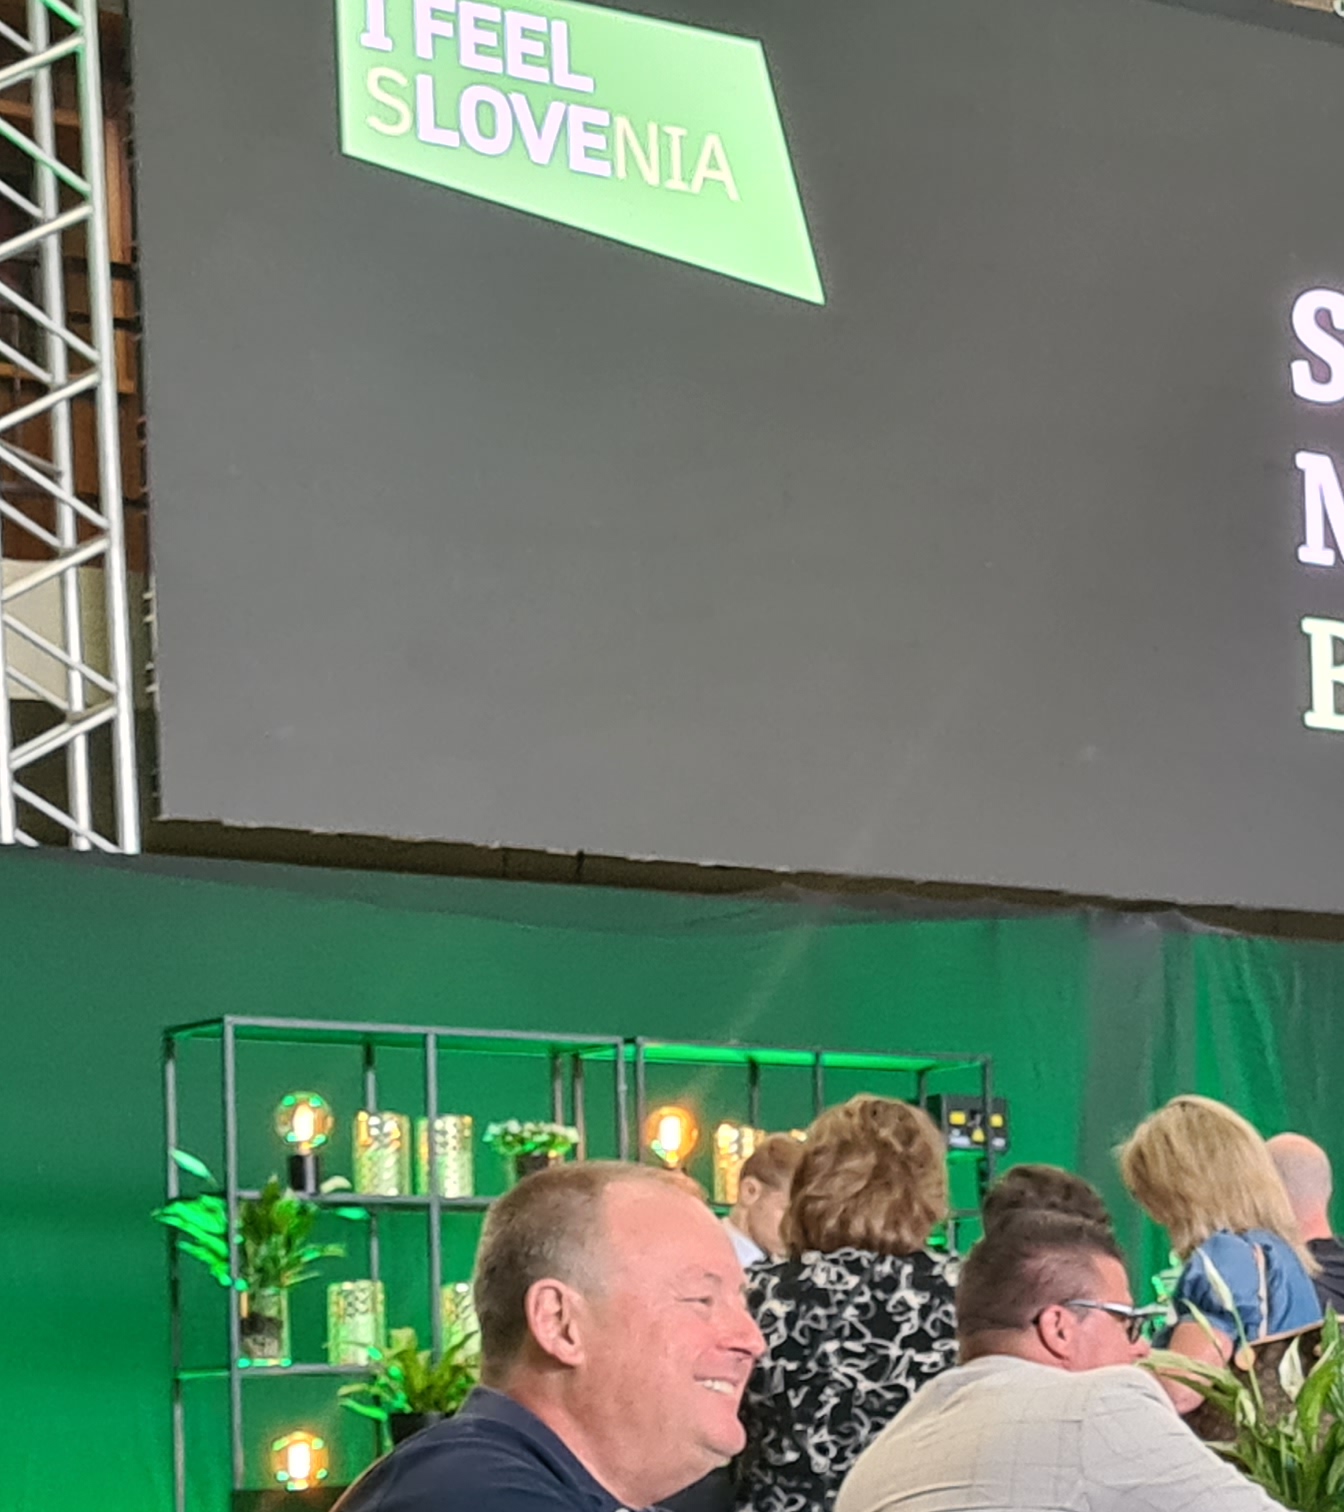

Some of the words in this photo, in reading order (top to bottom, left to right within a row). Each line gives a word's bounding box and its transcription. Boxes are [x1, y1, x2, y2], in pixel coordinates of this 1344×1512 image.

[359, 0, 393, 52] I
[413, 0, 595, 93] FEEL
[364, 66, 741, 202] SLOVENIA
